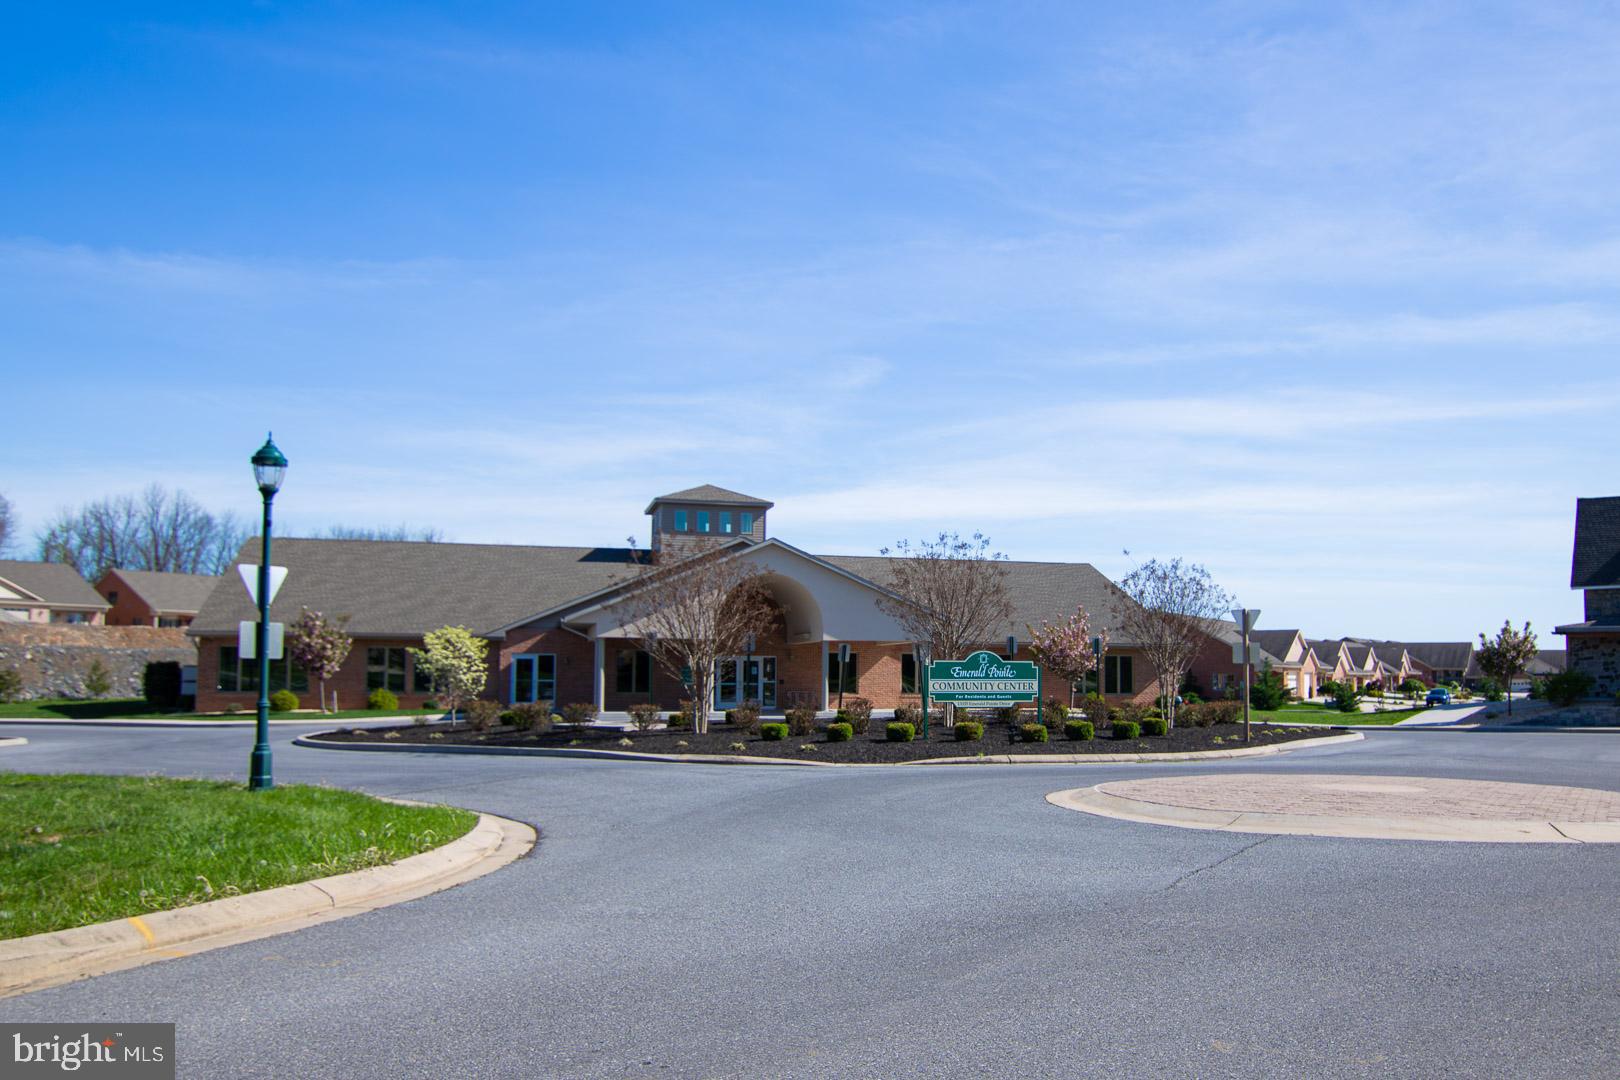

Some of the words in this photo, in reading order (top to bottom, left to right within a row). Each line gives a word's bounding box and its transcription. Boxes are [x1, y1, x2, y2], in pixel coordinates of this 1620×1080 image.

[950, 663, 989, 678] Emerald
[987, 663, 1017, 678] Pointe
[932, 682, 995, 691] COMMUNITY
[997, 682, 1034, 691] CENTER
